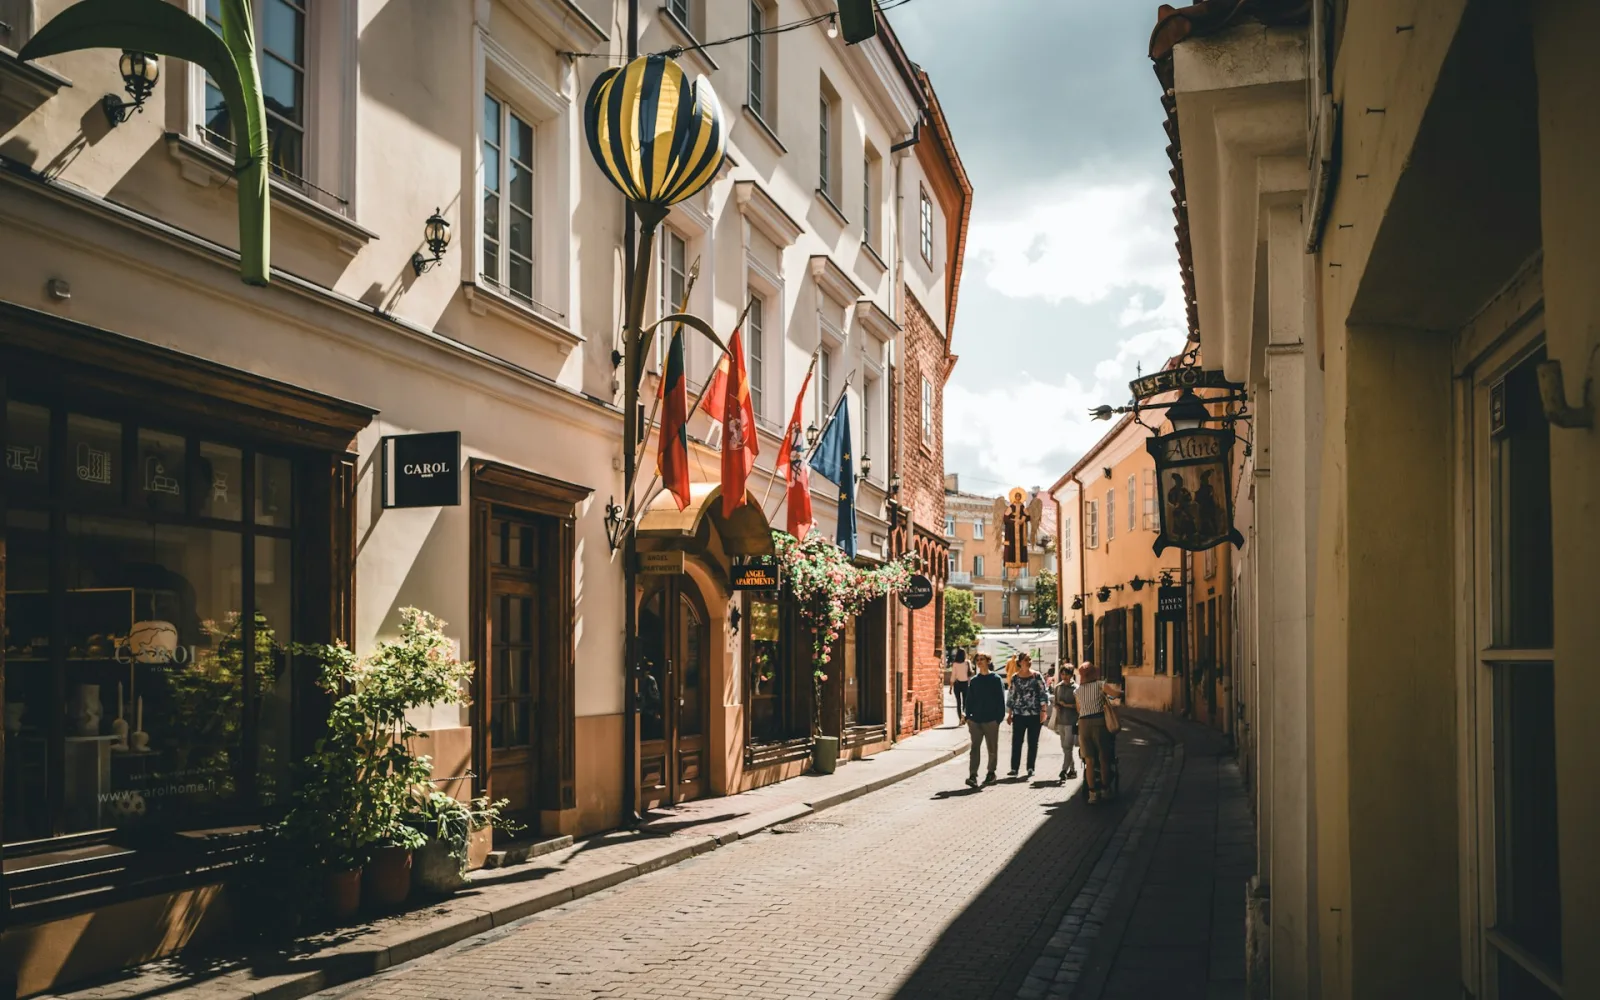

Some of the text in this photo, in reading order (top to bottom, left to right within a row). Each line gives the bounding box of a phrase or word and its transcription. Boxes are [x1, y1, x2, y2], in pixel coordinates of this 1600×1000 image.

[403, 462, 450, 475] CAROL
[744, 569, 766, 578] ANGEL
[735, 577, 776, 585] APARTMENTS
